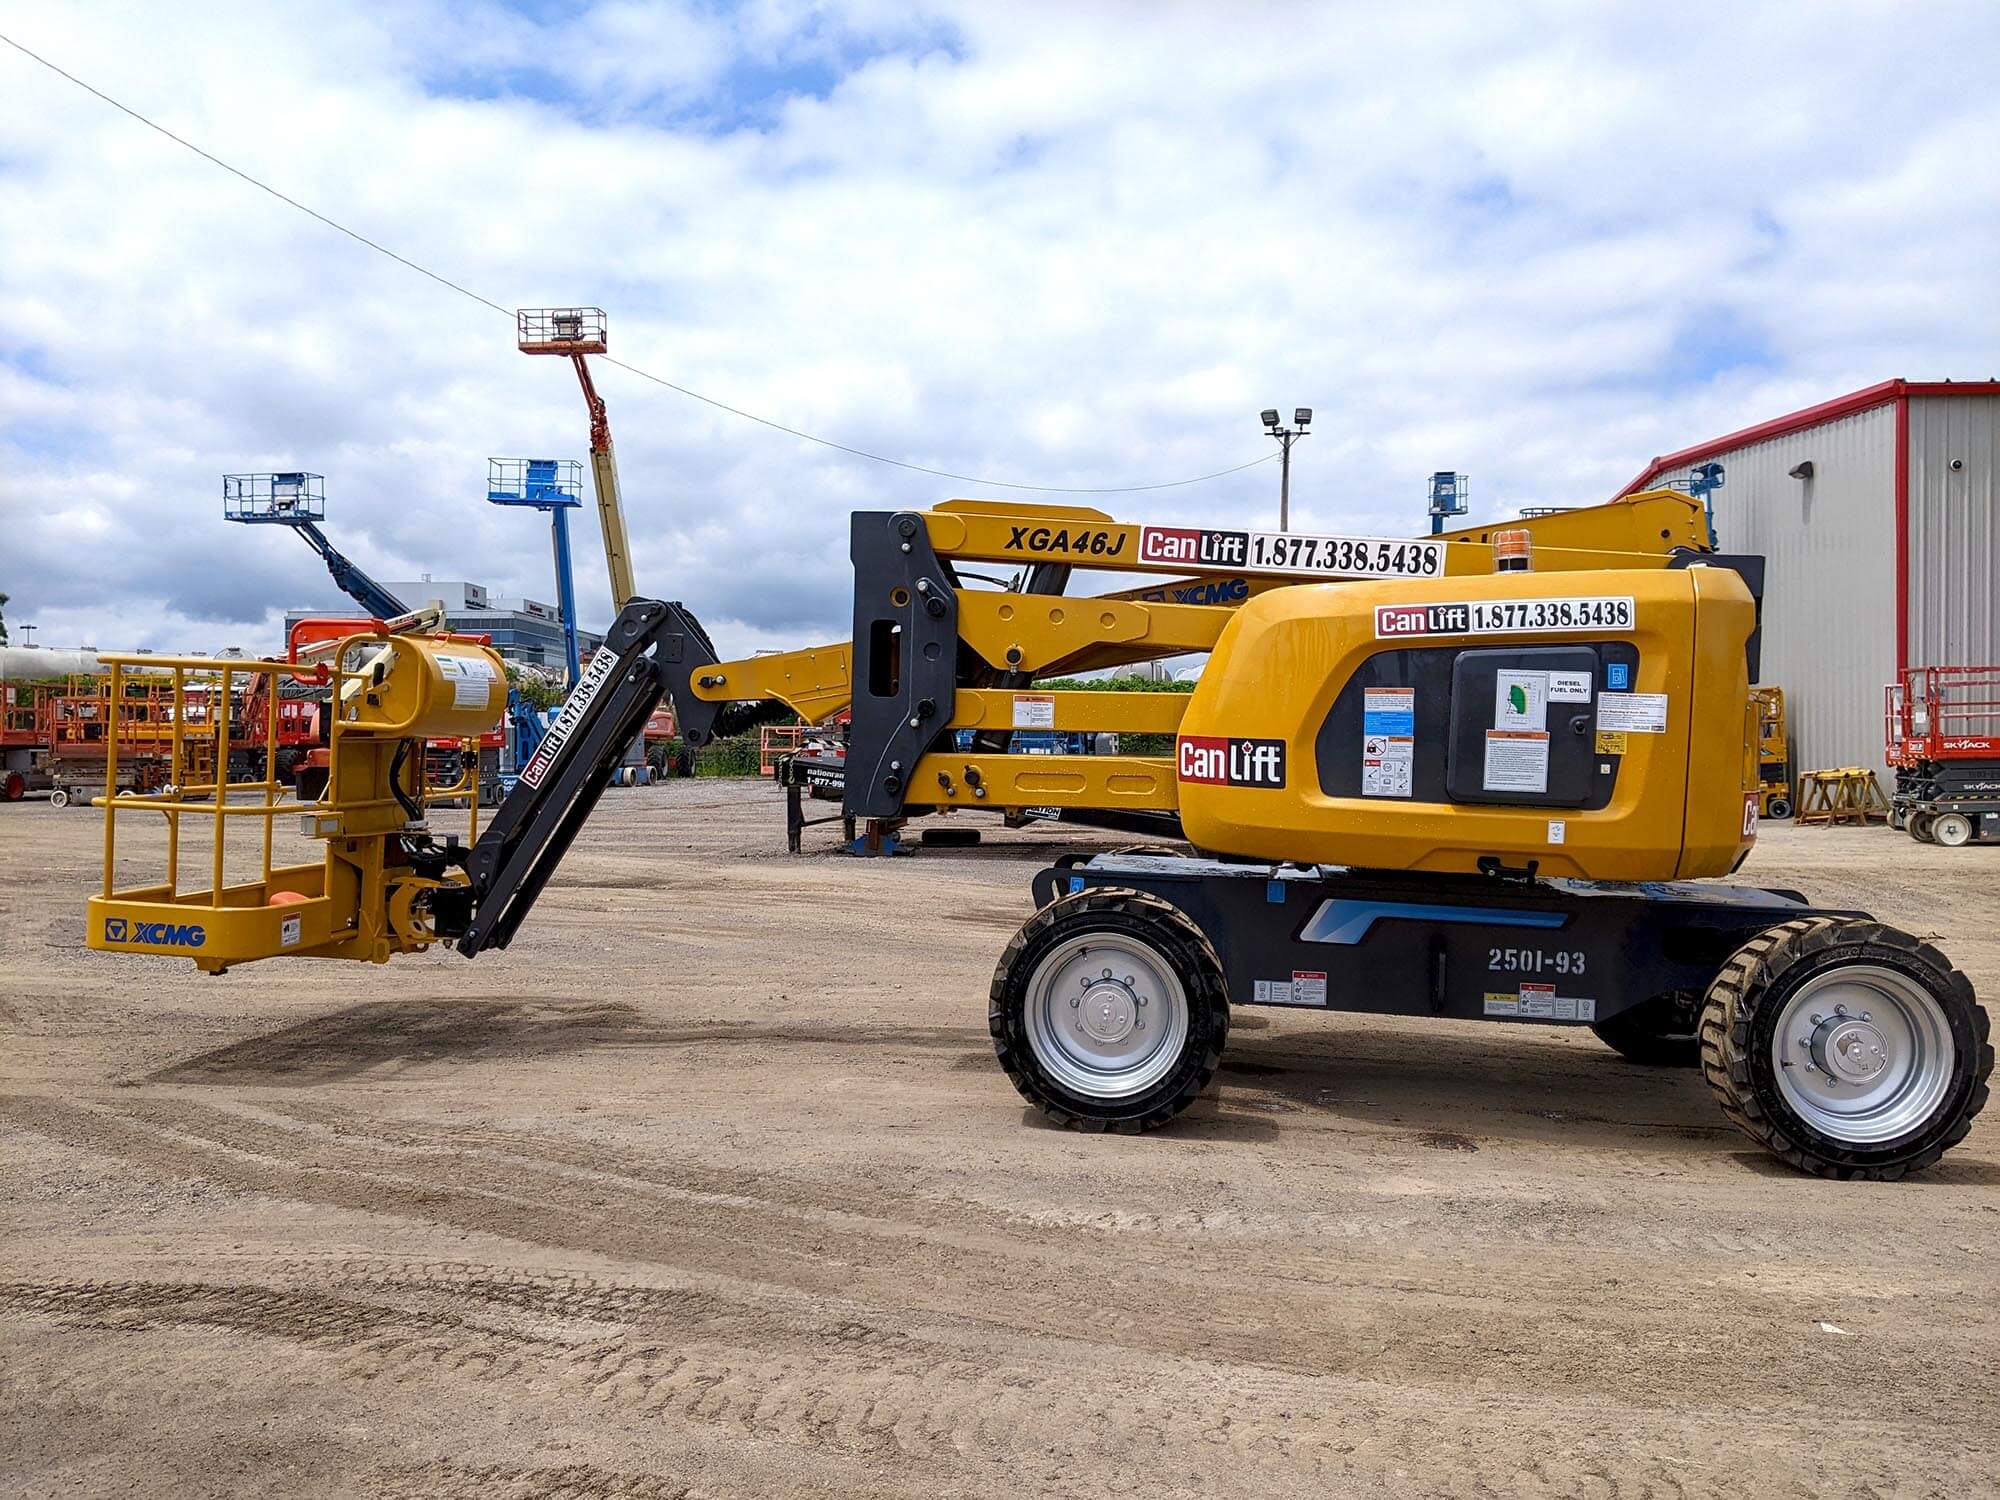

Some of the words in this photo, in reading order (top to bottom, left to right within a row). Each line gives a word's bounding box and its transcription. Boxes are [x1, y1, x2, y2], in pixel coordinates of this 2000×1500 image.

[1004, 527, 1127, 556] XGA46J
[1254, 538, 1438, 575] 1.877.338.5438
[1171, 578, 1249, 605] XCMG
[1475, 601, 1629, 629] 1.877.338.5438
[552, 651, 614, 737] 1.877.338.5438
[1943, 739, 1991, 750] SKYJACK
[130, 922, 206, 947] XCMG
[1488, 948, 1587, 975] 2501-93
